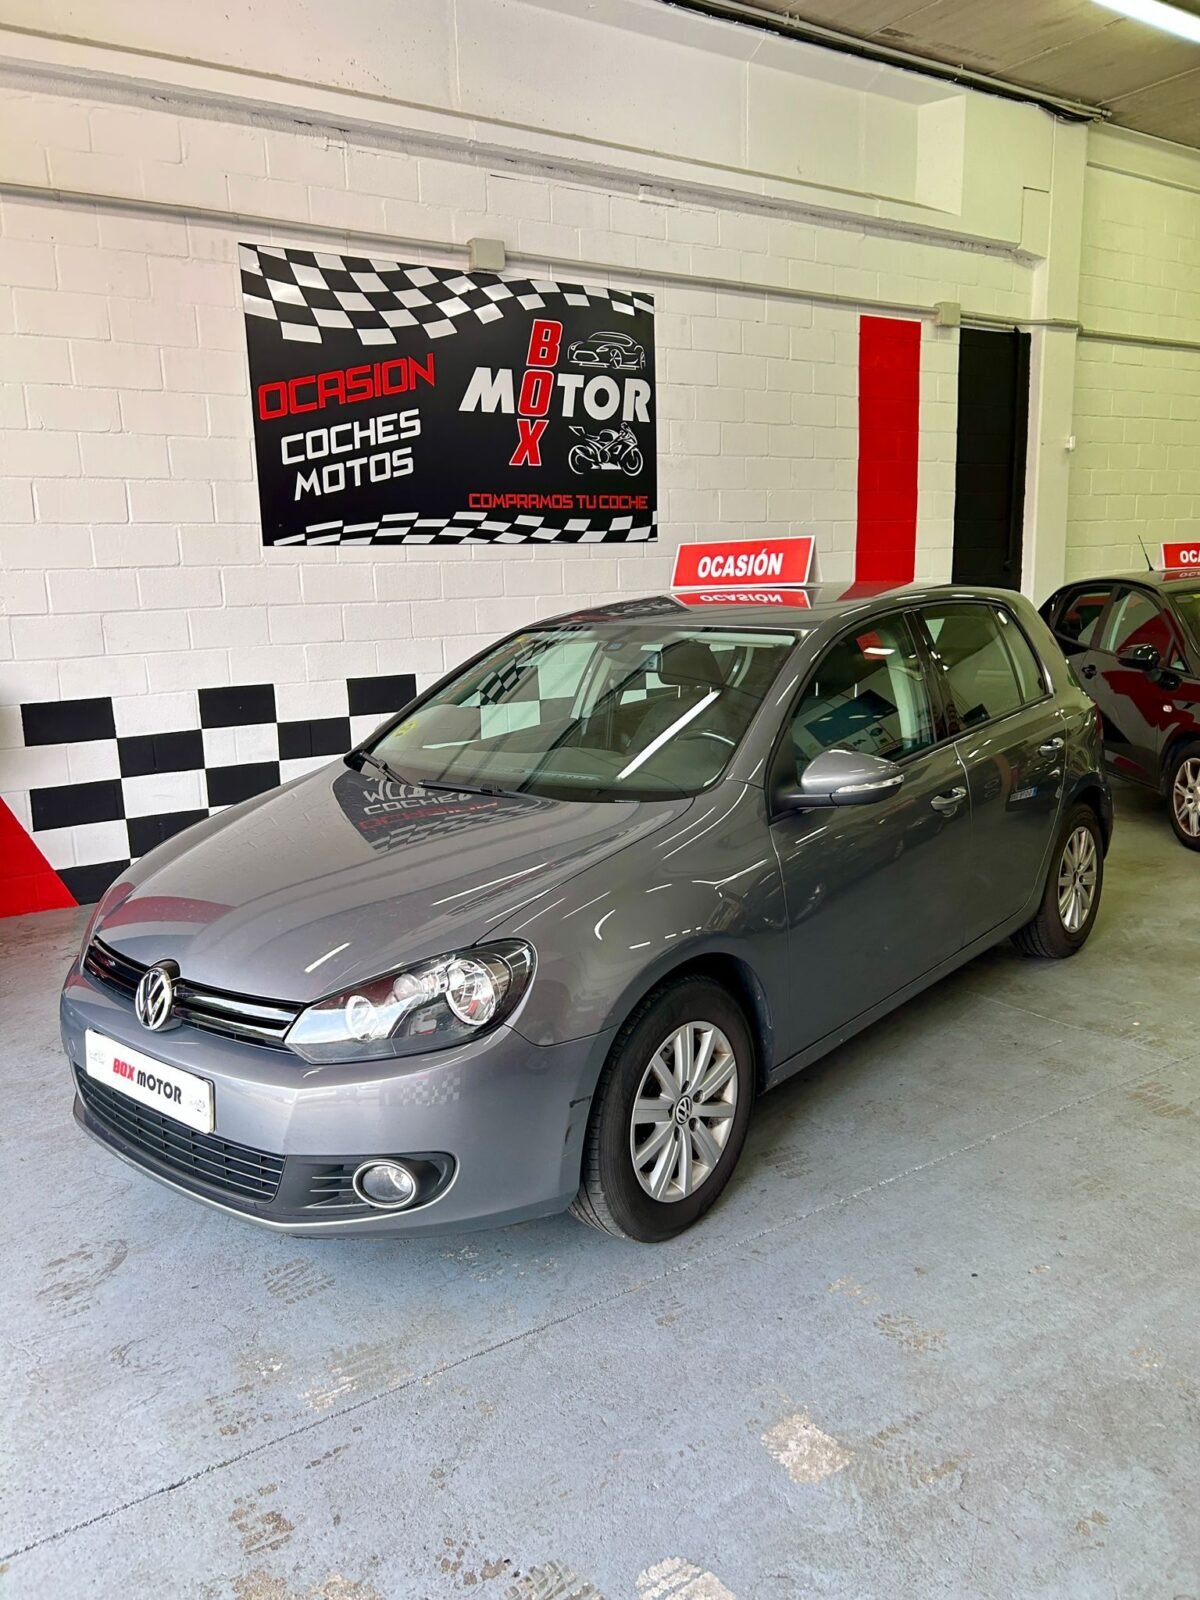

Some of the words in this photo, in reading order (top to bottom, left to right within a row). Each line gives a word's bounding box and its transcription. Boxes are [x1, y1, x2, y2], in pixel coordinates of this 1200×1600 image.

[257, 352, 436, 421] OCASION
[509, 318, 564, 467] BOX
[280, 408, 422, 466] COCHES
[293, 447, 415, 502] MOTOS
[468, 493, 574, 510] COMPRAMOS
[576, 495, 597, 510] TU
[598, 495, 649, 510] COCHE
[697, 548, 784, 579] OCASIÓN
[1179, 549, 1200, 564] OC
[112, 1057, 136, 1081] BOX
[136, 1069, 182, 1105] MOTOR
